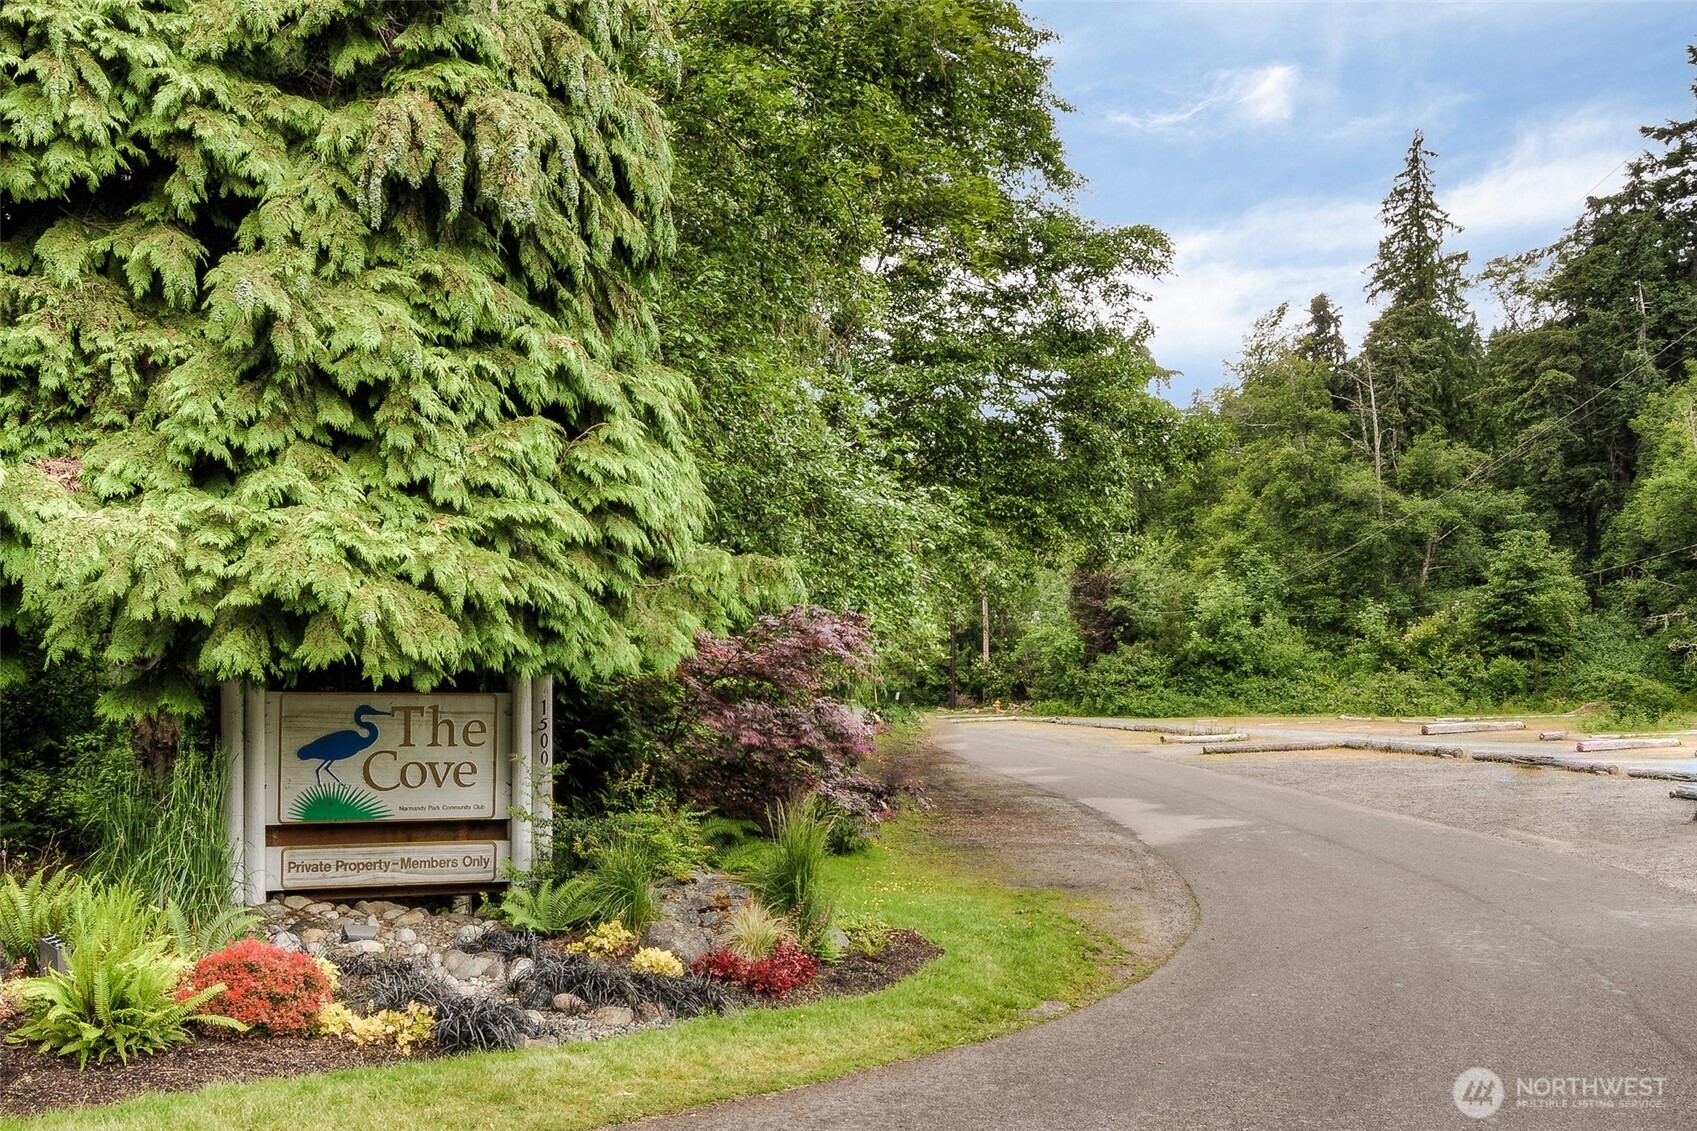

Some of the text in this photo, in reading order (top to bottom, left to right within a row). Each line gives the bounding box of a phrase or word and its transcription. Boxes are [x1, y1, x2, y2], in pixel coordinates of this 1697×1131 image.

[391, 704, 487, 748] The
[538, 699, 549, 766] 1500
[362, 750, 478, 792] Cove
[287, 861, 332, 873] Private
[462, 855, 490, 869] Only
